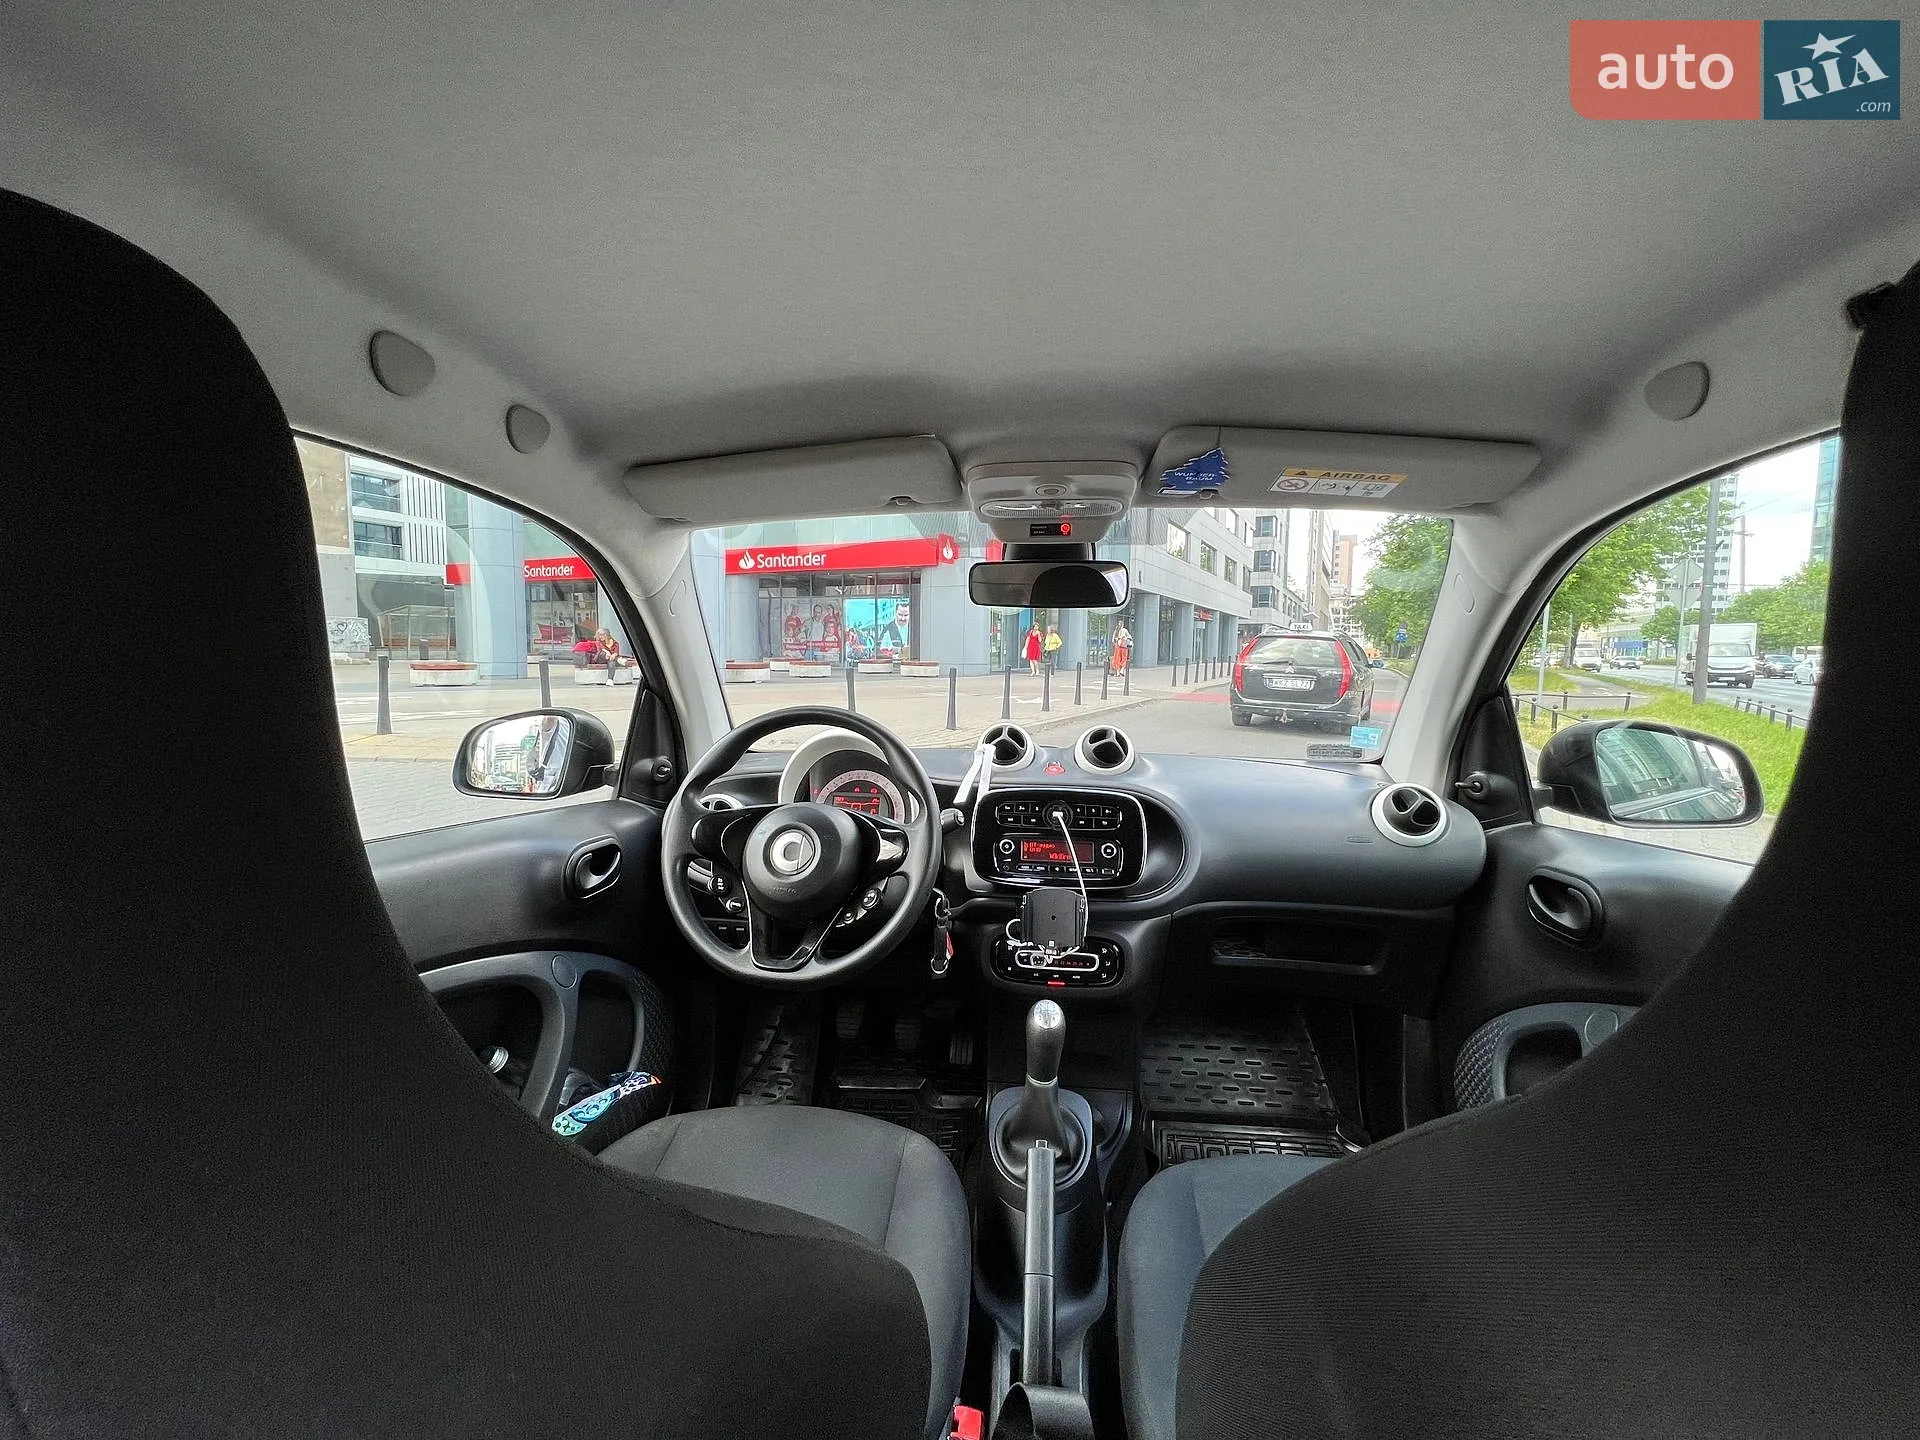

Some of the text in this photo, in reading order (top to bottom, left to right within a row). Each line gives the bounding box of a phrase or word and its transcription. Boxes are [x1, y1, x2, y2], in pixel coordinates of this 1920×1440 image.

[1320, 471, 1391, 481] AIRBAG
[757, 552, 827, 568] Santander
[523, 563, 574, 577] Santander
